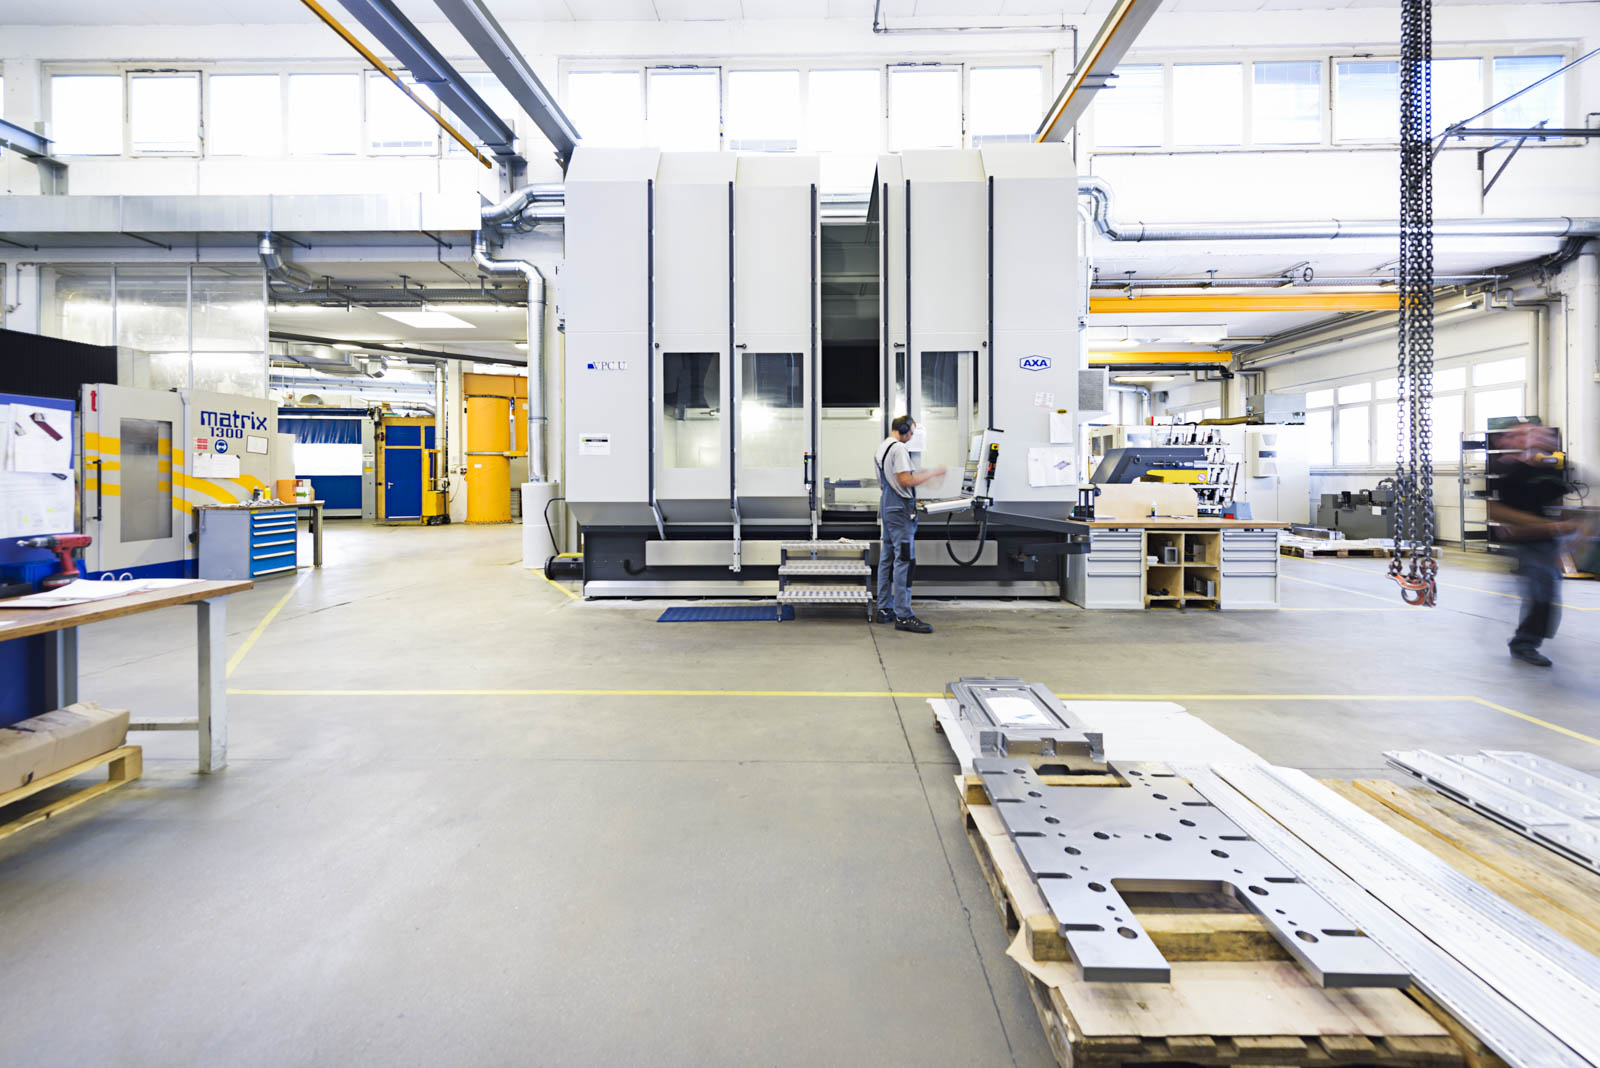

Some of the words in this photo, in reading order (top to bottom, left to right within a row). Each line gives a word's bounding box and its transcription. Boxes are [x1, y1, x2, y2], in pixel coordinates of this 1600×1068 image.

[1023, 359, 1048, 367] AXA
[200, 410, 267, 431] matrix
[209, 426, 243, 439] 1300
